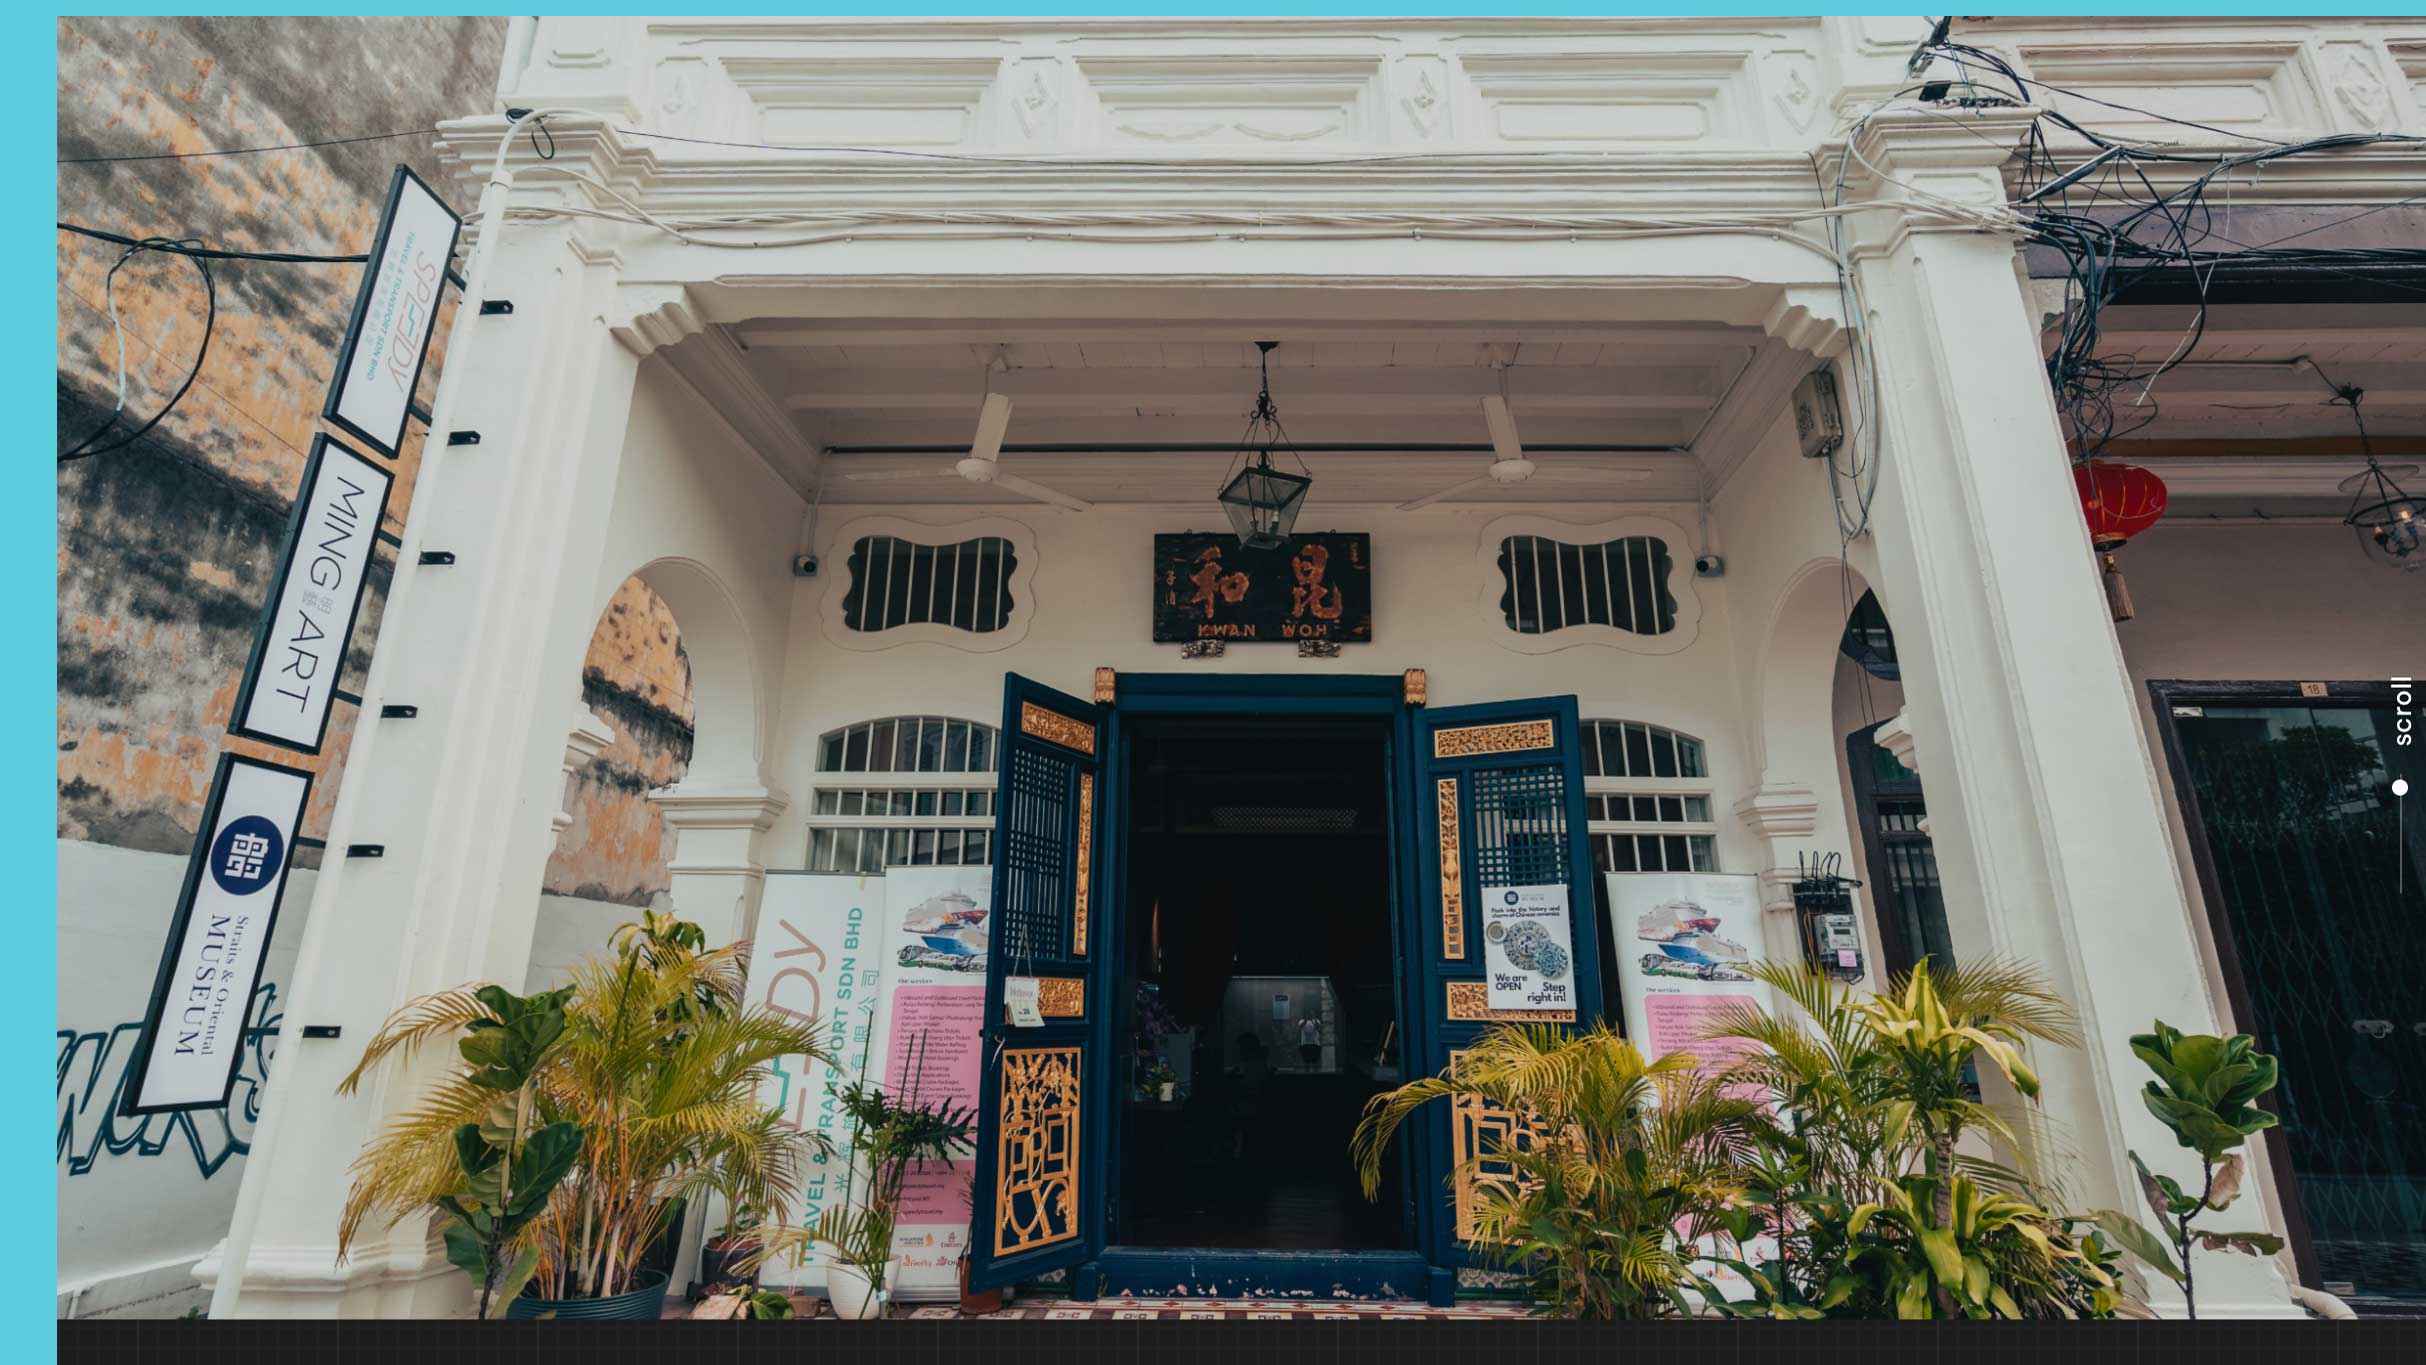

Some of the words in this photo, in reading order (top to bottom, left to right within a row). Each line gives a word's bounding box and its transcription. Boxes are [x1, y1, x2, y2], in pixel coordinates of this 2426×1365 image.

[310, 476, 365, 591] MING
[1197, 623, 1256, 638] KWAN
[1281, 623, 1328, 638] WOH
[275, 609, 325, 713] ART
[2307, 683, 2321, 696] 18
[225, 914, 249, 965] Straits
[843, 906, 863, 950] BHD
[173, 913, 232, 1057] MUSEUM
[219, 969, 236, 984] &
[837, 957, 857, 1000] SDN
[1495, 973, 1511, 982] We
[1495, 982, 1522, 991] OPEN
[1542, 982, 1566, 993] Step
[1527, 992, 1552, 1004] right
[1553, 992, 1566, 1002] in!
[200, 987, 230, 1056] Oriental
[816, 1007, 849, 1139] TRANSPORT
[812, 1152, 829, 1166] &
